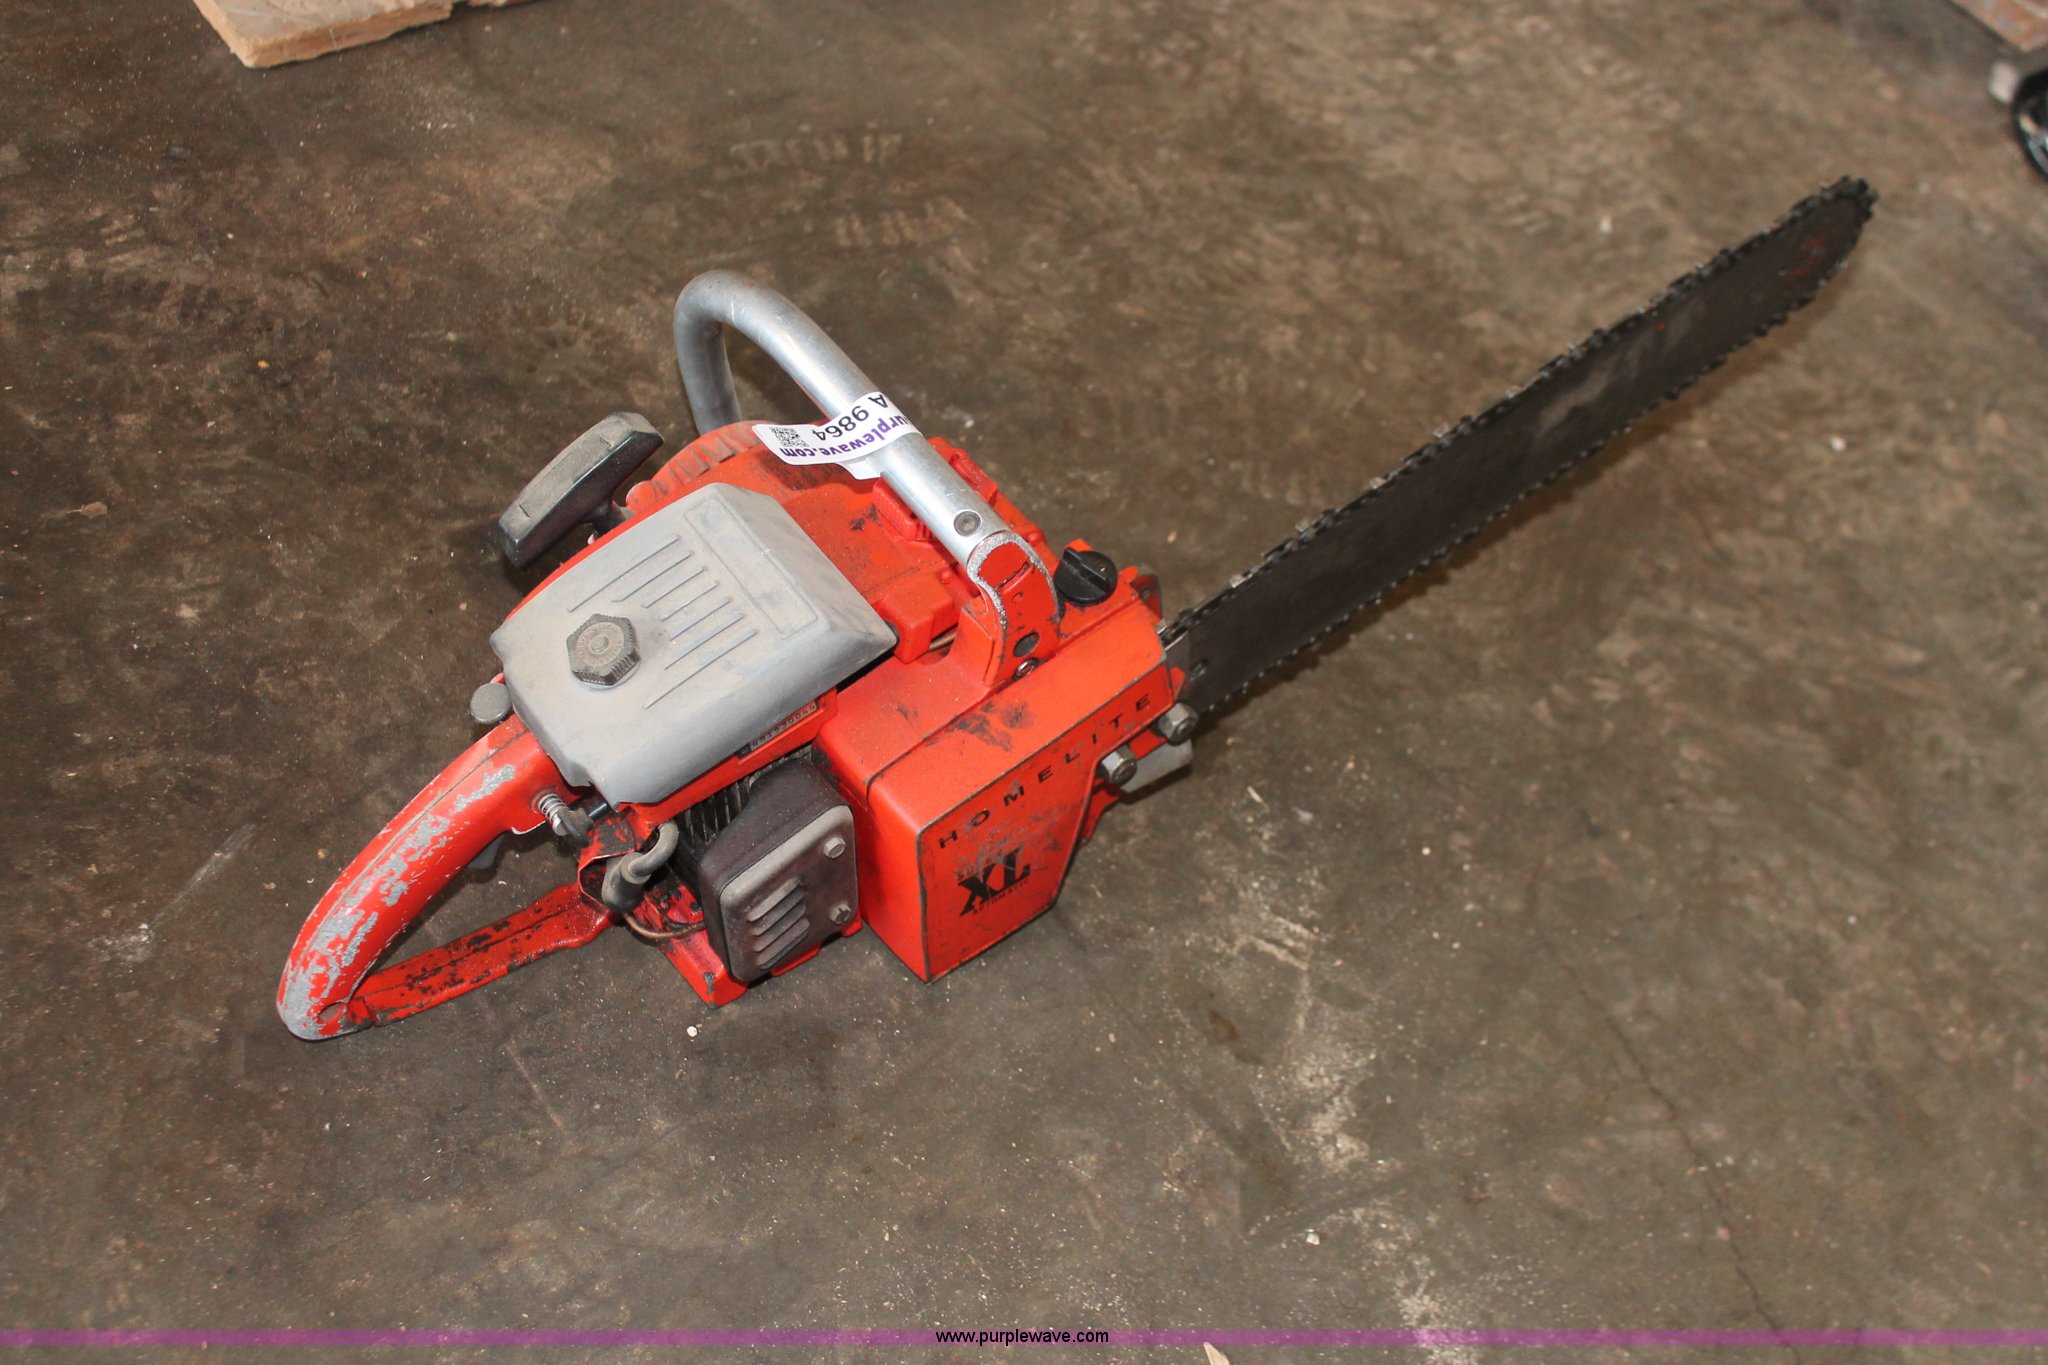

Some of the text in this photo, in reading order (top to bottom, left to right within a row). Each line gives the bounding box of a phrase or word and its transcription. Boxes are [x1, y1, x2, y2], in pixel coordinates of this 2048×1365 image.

[779, 414, 907, 457] urplewave.com
[812, 394, 889, 442] A 9864
[938, 694, 1150, 849] HOMELITE
[957, 845, 1031, 918] XL
